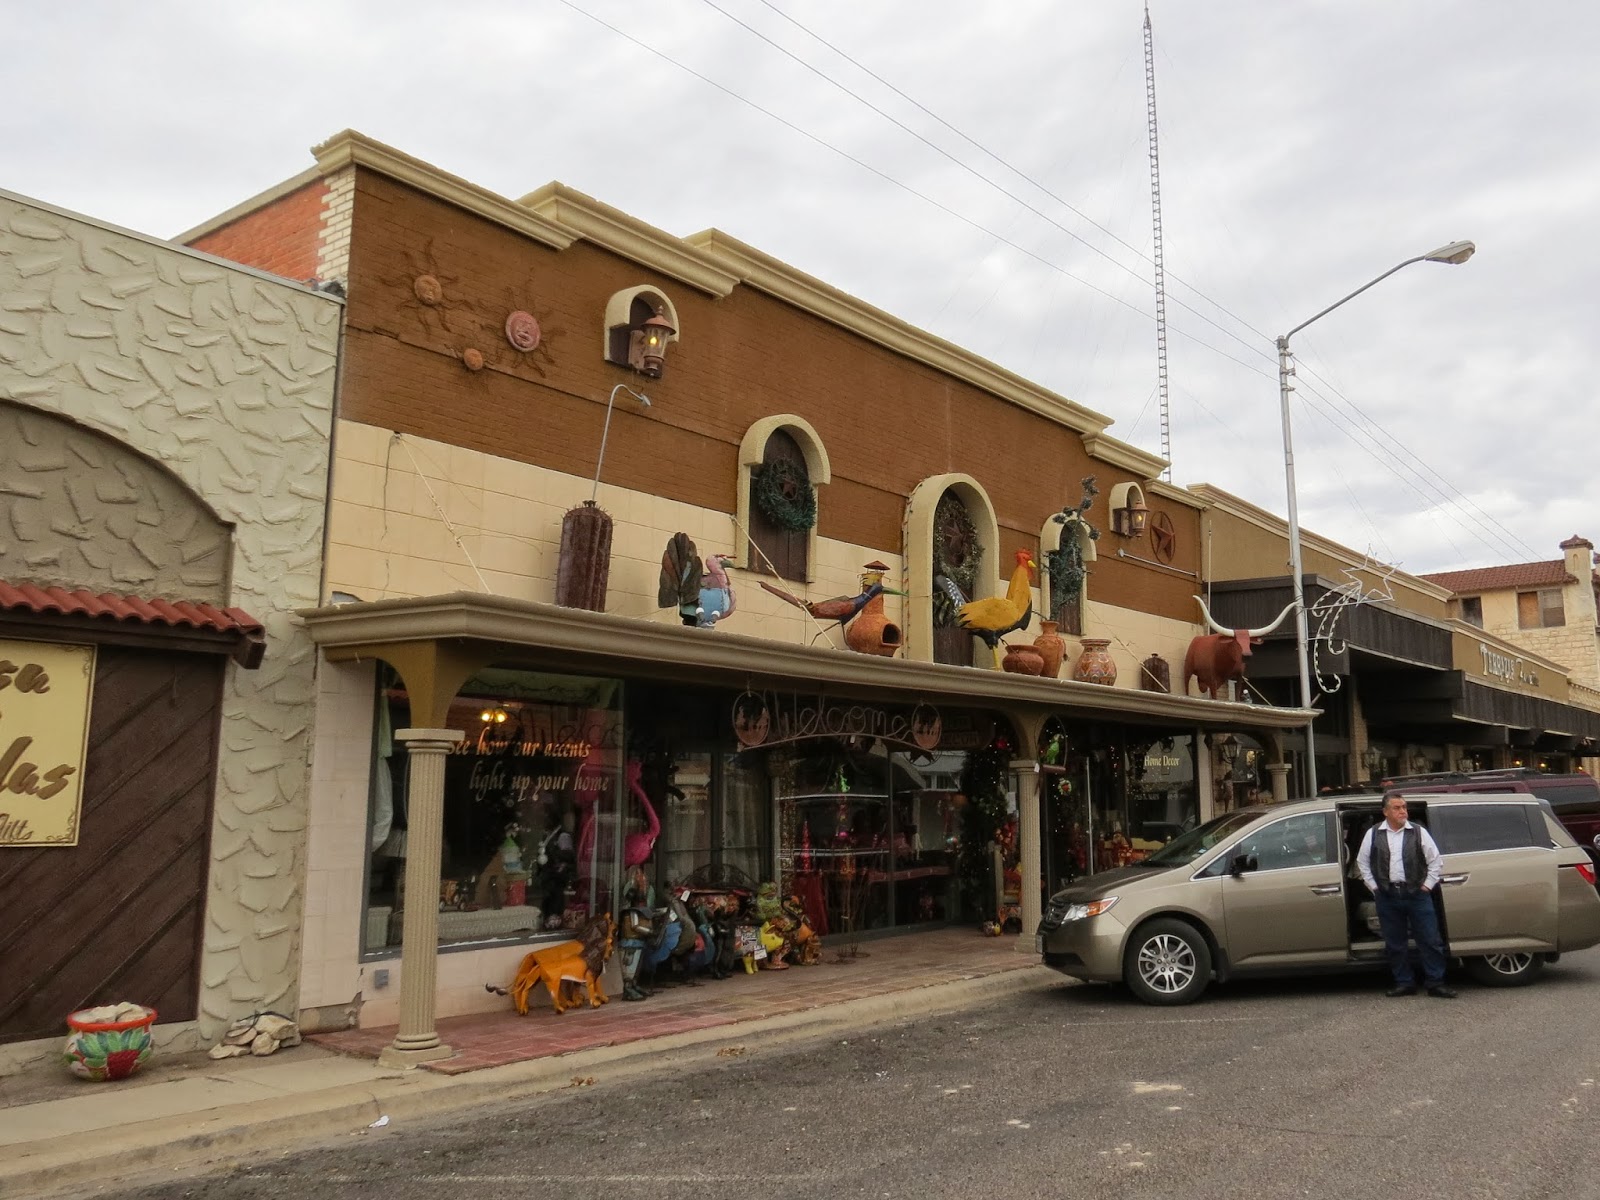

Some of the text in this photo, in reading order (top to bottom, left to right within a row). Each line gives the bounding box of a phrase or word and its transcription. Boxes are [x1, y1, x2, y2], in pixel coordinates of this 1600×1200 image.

[544, 742, 592, 758] accents
[1144, 756, 1180, 767] Home Decor
[469, 761, 609, 802] light up your home
